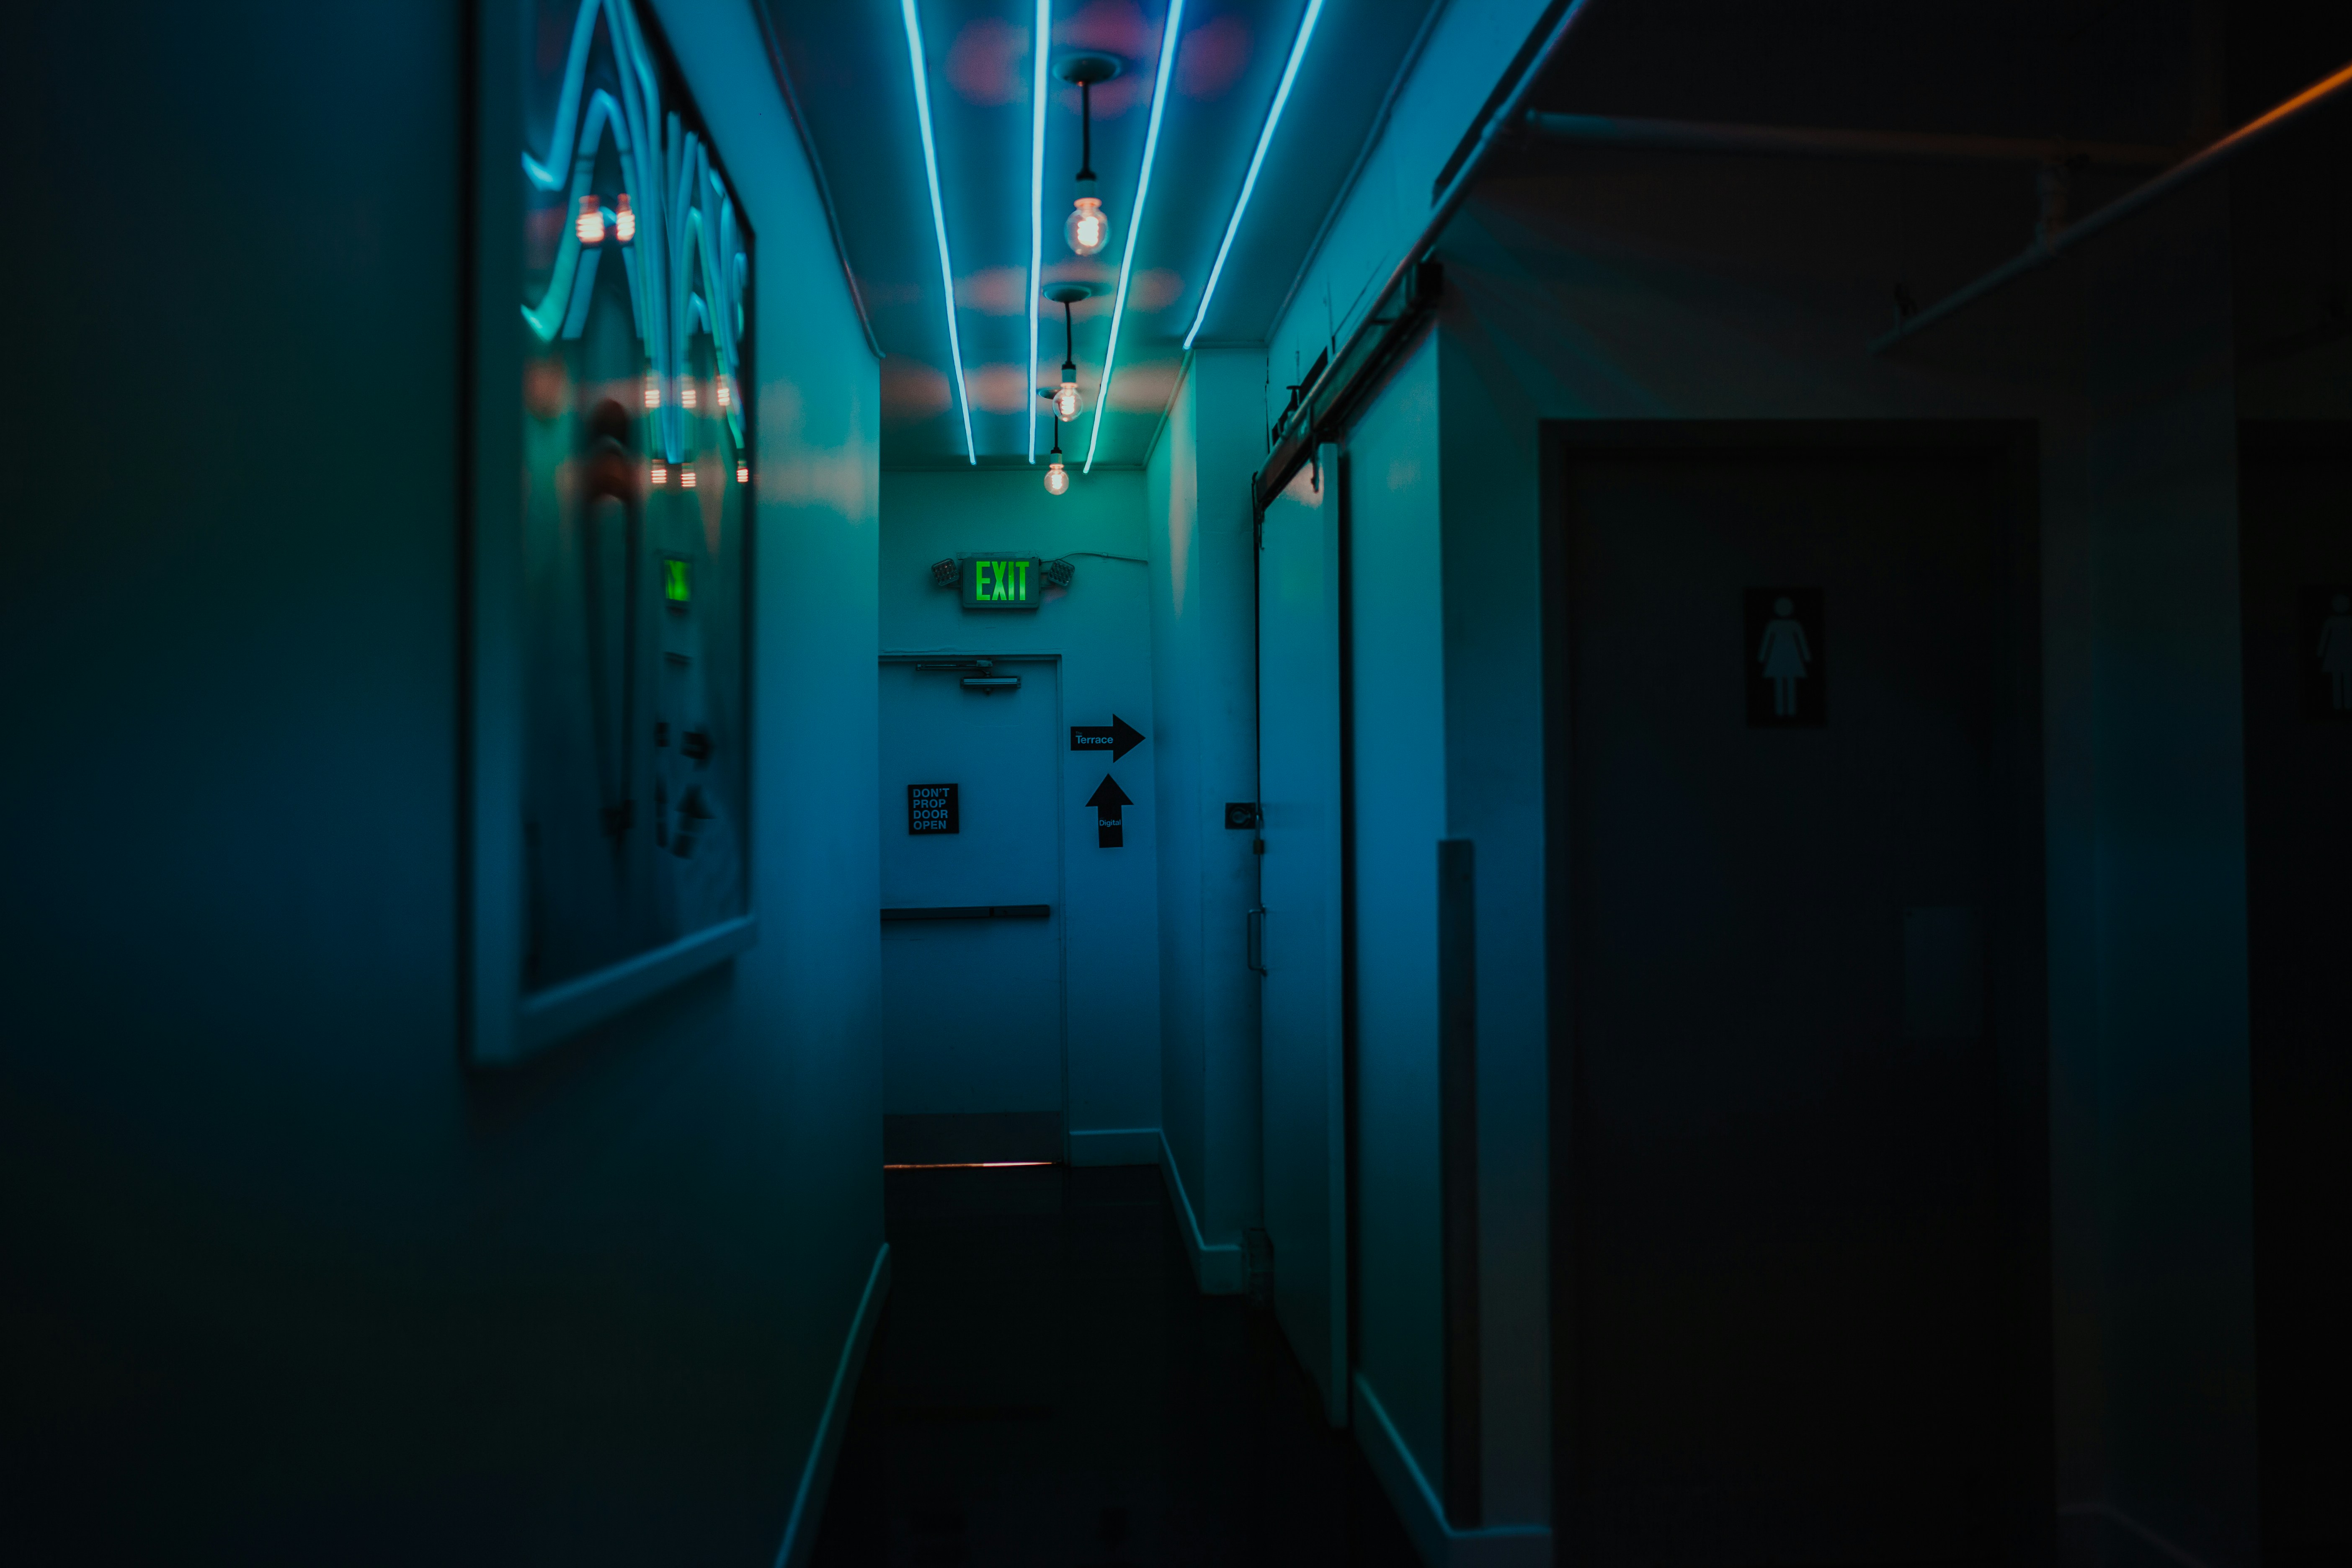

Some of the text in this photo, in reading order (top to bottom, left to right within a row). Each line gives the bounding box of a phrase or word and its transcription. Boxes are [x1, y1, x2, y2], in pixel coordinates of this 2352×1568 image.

[976, 561, 1029, 601] EXIT
[1075, 735, 1113, 744] Terrace
[913, 788, 949, 797] DON'T
[913, 799, 946, 808] PROP
[913, 810, 948, 819] DOOR
[913, 820, 946, 830] OPEN
